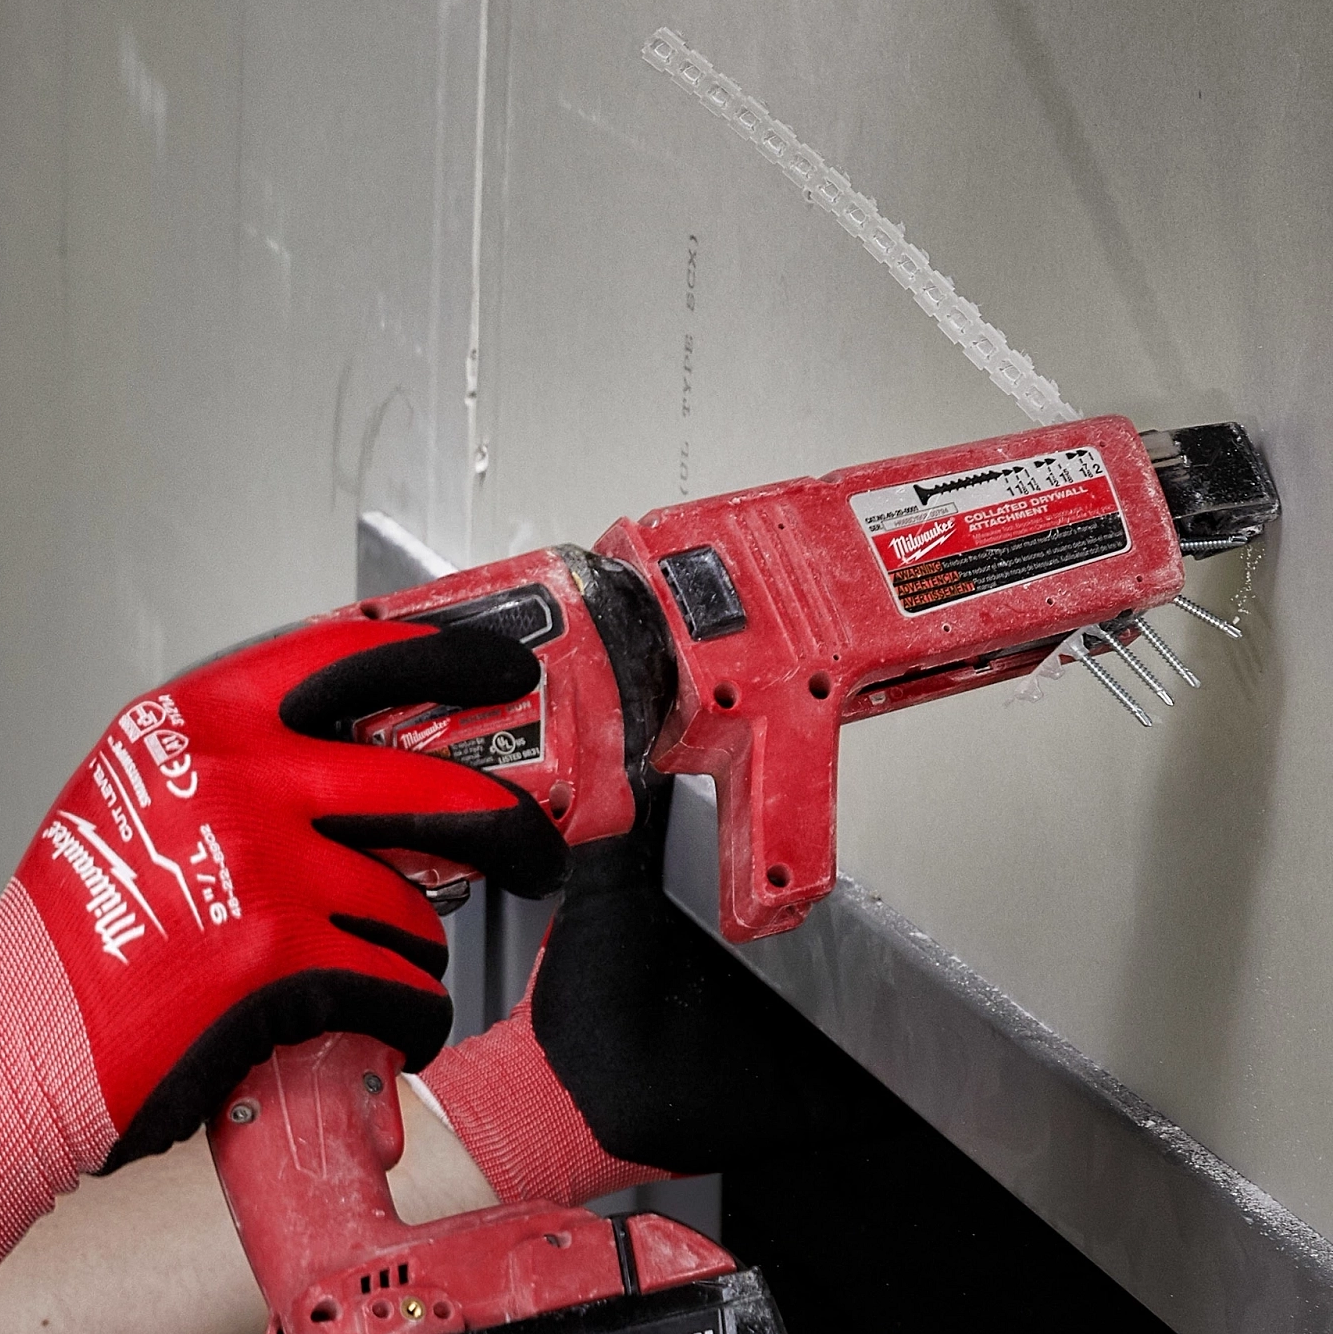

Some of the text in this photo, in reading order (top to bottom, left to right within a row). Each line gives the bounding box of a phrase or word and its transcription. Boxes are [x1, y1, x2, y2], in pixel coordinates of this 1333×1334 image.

[683, 333, 693, 417] TYPE
[1092, 462, 1102, 474] 2
[963, 499, 1027, 523] COLLATED
[1029, 484, 1088, 506] DRYWALL
[968, 504, 1049, 531] ATTACHMENT
[889, 517, 956, 559] Milwaukee
[897, 570, 959, 595] ADVERTENCIA
[900, 561, 942, 580] WARNING
[903, 580, 975, 608] AVERTISSEMENT
[400, 719, 449, 749] Milwaukee
[91, 767, 117, 808] LEVEL
[111, 807, 133, 842] CUT
[189, 841, 208, 864] L
[42, 821, 145, 965] Milwaukee
